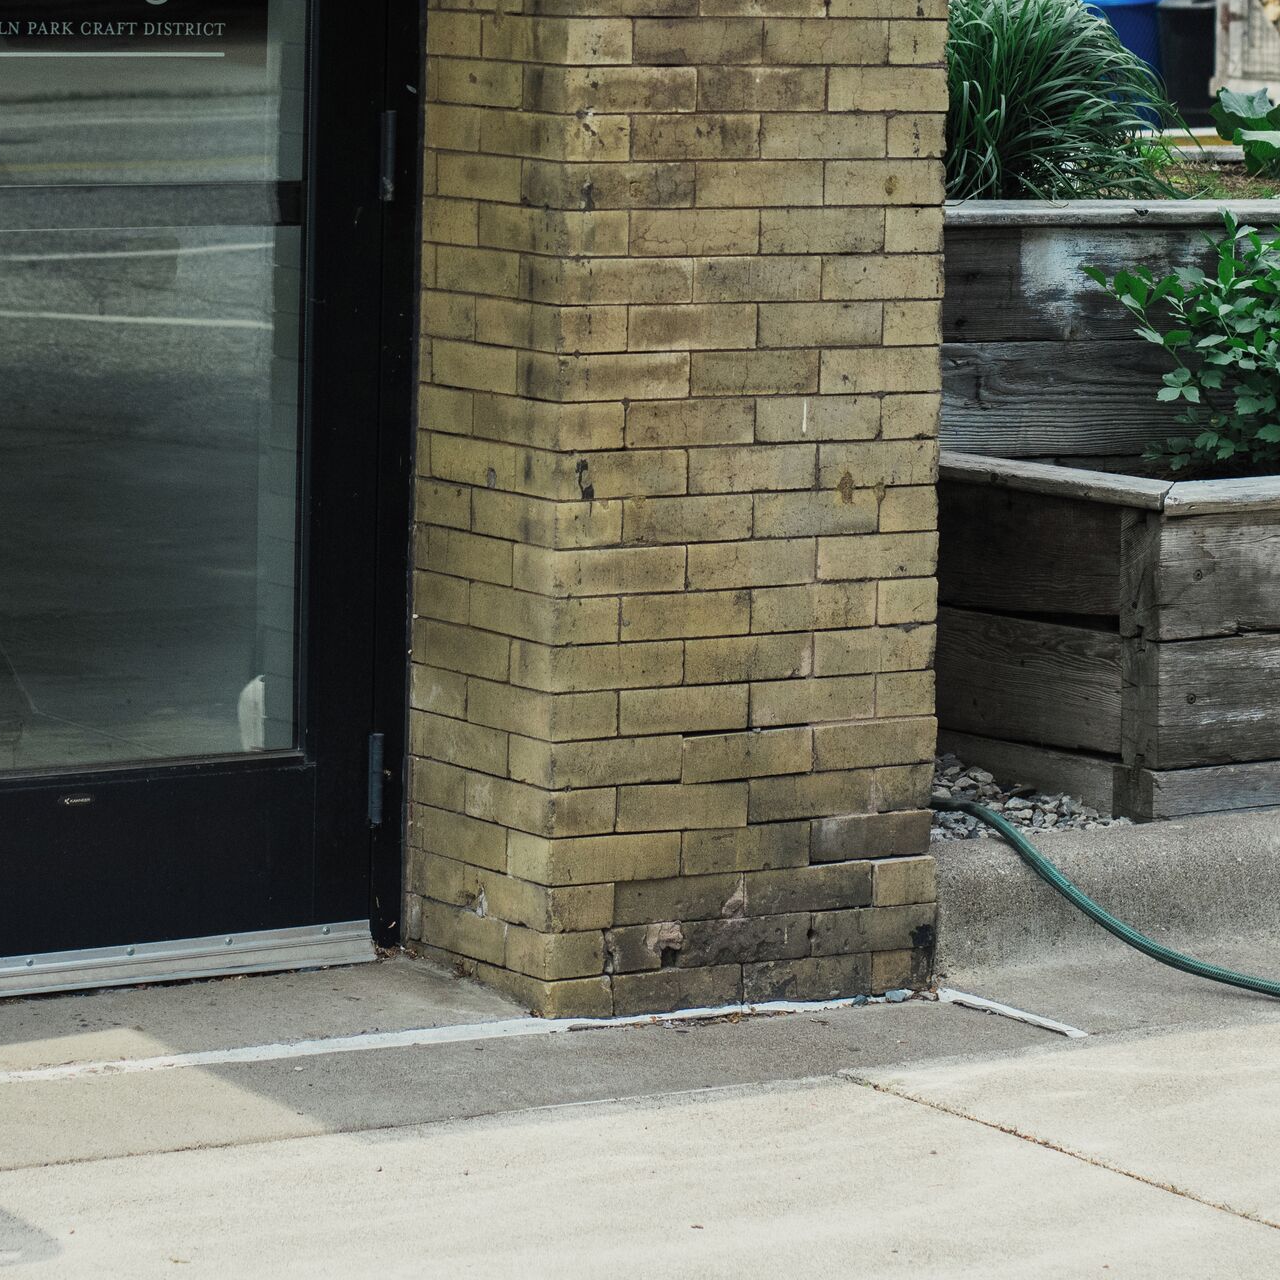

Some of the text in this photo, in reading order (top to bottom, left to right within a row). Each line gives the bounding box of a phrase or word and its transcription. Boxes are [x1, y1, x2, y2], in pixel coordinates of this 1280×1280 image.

[28, 22, 73, 36] PARK
[80, 22, 138, 37] CRAFT
[144, 22, 226, 37] DISTRICT
